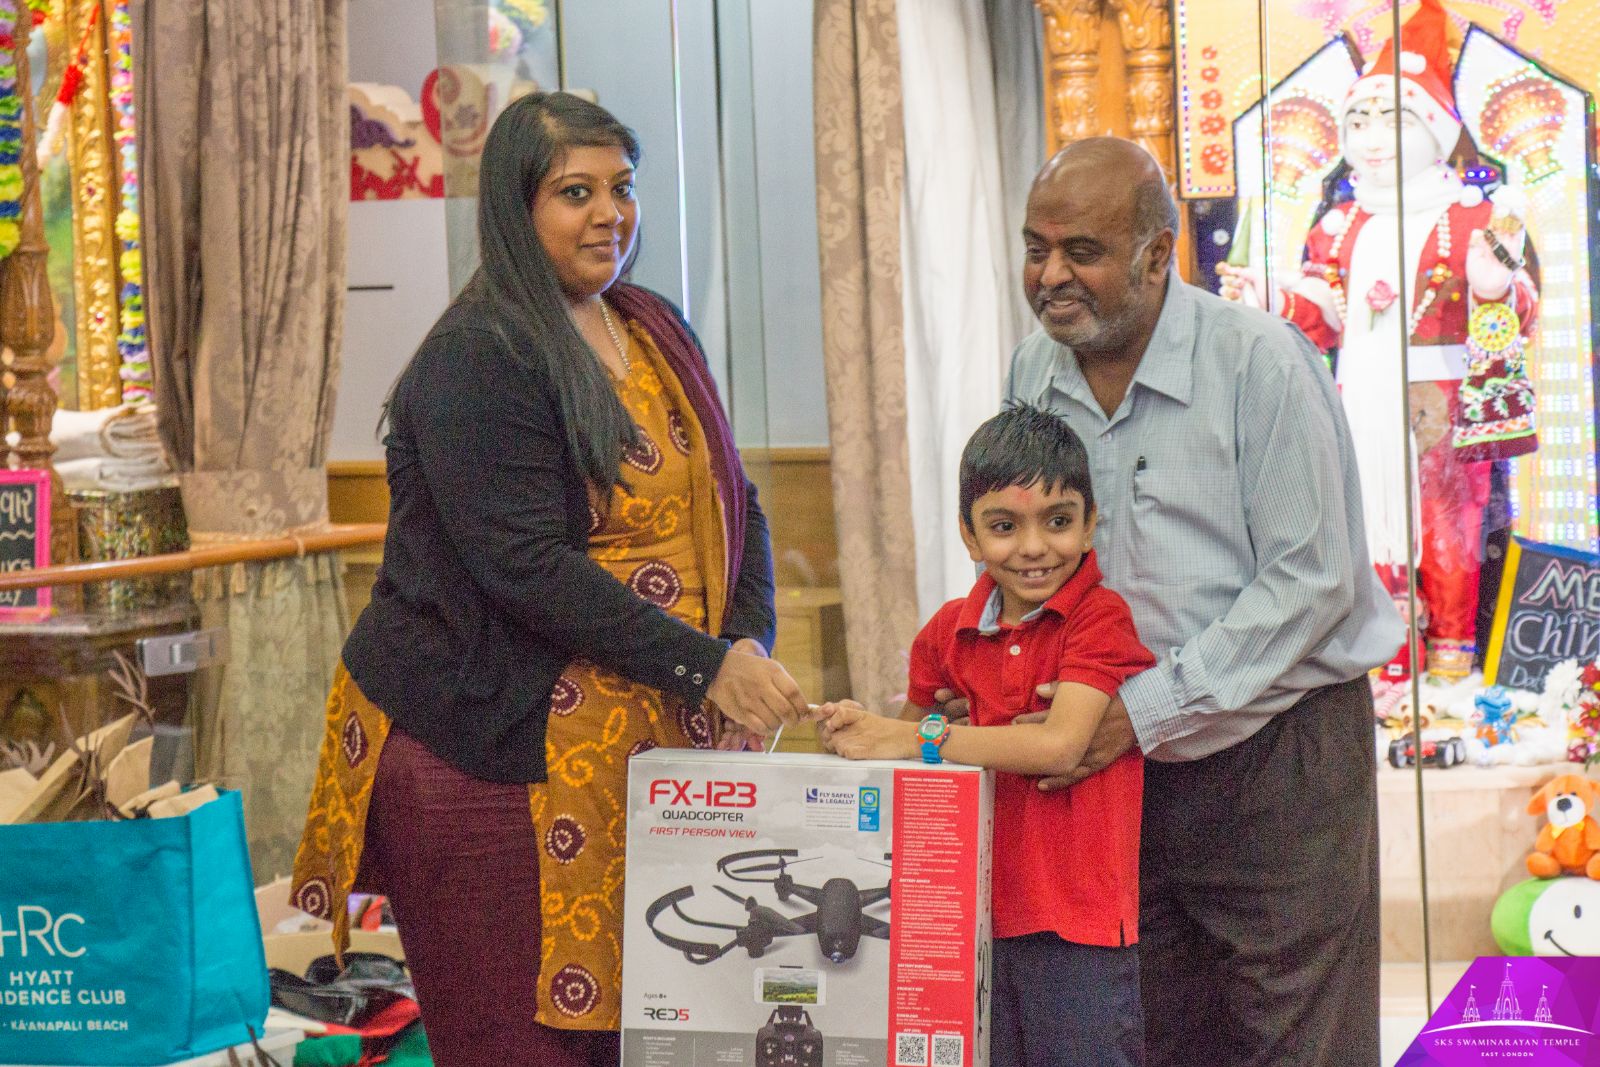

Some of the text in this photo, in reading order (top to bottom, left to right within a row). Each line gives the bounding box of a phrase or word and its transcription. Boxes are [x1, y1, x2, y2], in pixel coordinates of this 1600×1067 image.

[649, 779, 757, 808] FX-123
[819, 791, 831, 799] FLY
[662, 810, 744, 822] QUADCOPTER
[649, 826, 757, 839] FIRST PERSON VIEW
[9, 970, 74, 986] HYATT
[77, 989, 126, 1004] CLUB
[86, 1020, 129, 1031] BEACH
